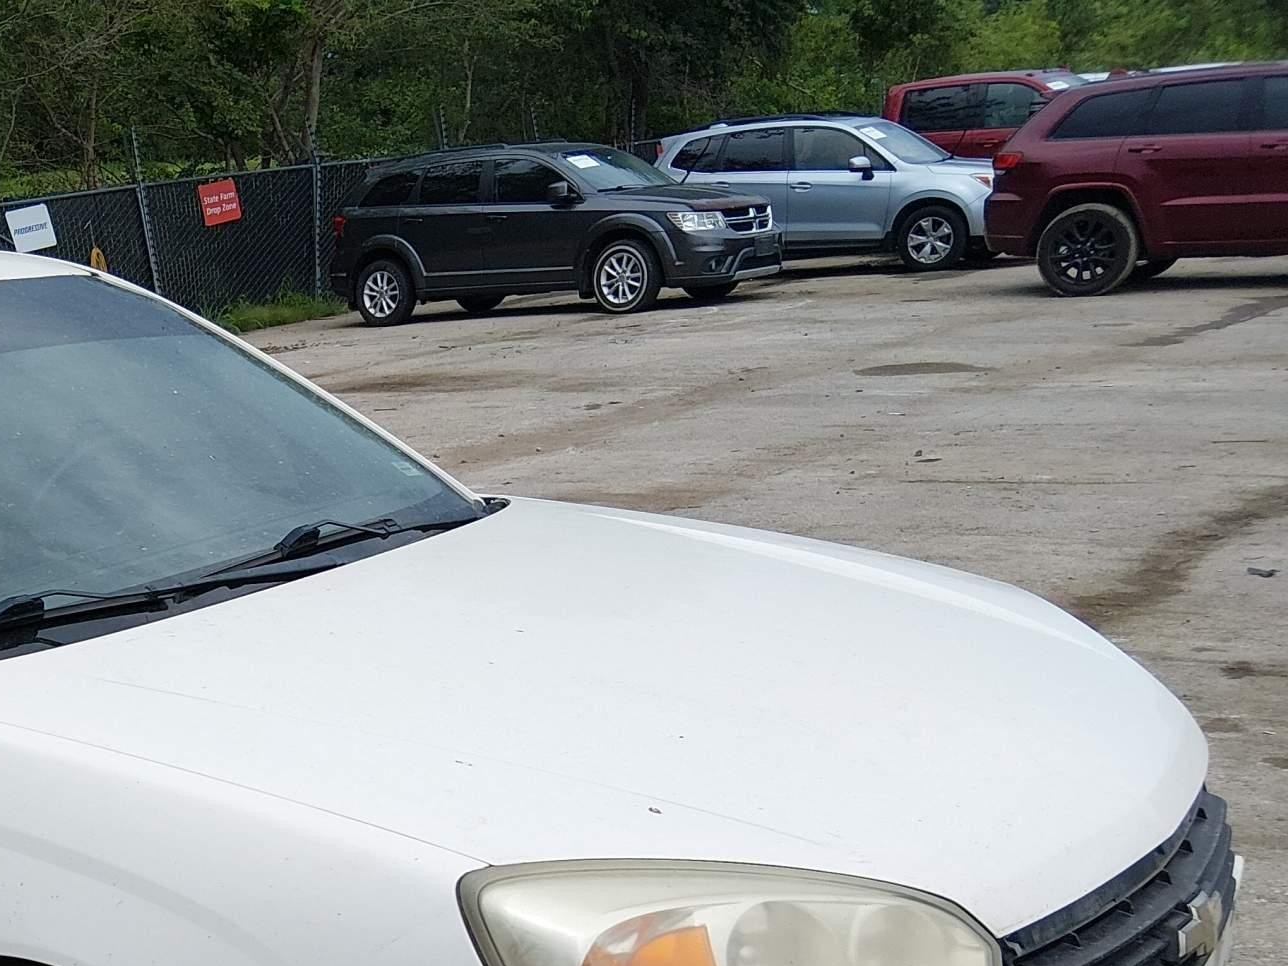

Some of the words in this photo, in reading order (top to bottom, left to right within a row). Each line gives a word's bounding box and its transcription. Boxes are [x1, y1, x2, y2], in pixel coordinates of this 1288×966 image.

[203, 195, 219, 205] State
[219, 192, 235, 201] Farm
[206, 206, 221, 216] Drop
[222, 202, 237, 212] Zone
